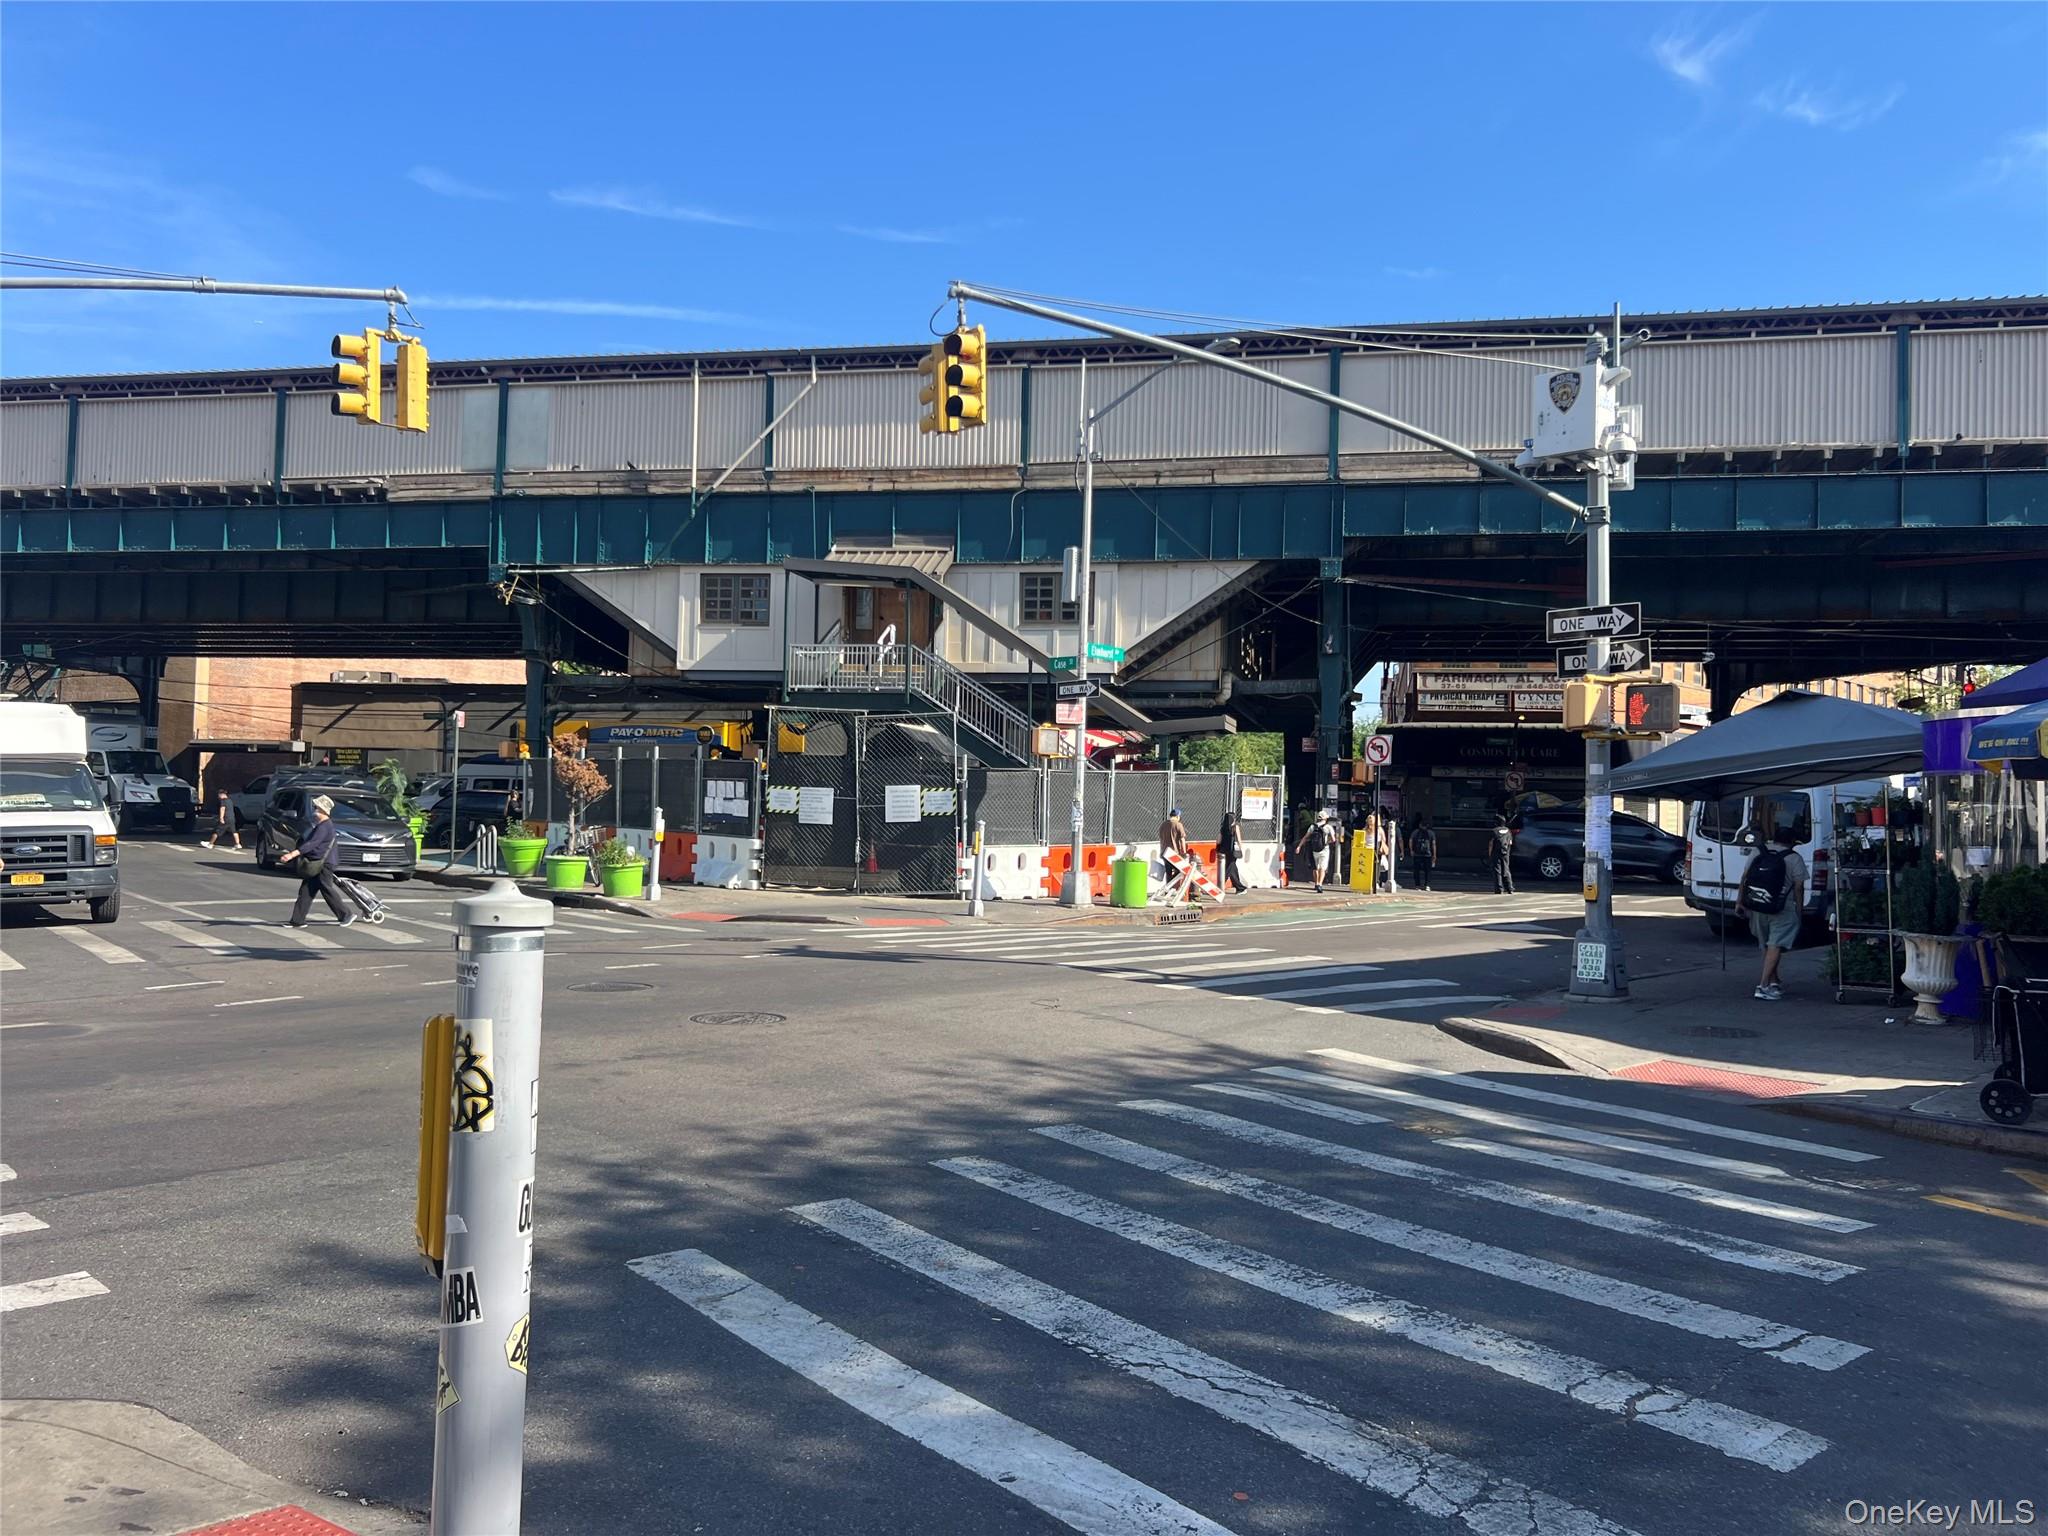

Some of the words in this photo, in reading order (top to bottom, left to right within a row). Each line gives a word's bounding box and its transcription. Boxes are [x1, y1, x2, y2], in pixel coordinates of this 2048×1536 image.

[1560, 617, 1584, 632] ONE
[1597, 614, 1625, 628] WAY
[1091, 645, 1114, 660] Elmhurst
[1053, 659, 1067, 669] Case
[1572, 655, 1588, 669] ON
[1609, 650, 1635, 665] WAY
[1434, 673, 1507, 684] FARMACIA
[1516, 674, 1534, 684] AL
[1062, 686, 1074, 694] ONE
[1079, 684, 1093, 693] WAY
[1429, 692, 1463, 701] PHYSICAL
[1464, 692, 1495, 701] THERAPY
[610, 727, 684, 737] PAY-O-MATIC
[1460, 746, 1504, 758] COSMOS
[1529, 746, 1560, 758] CARE
